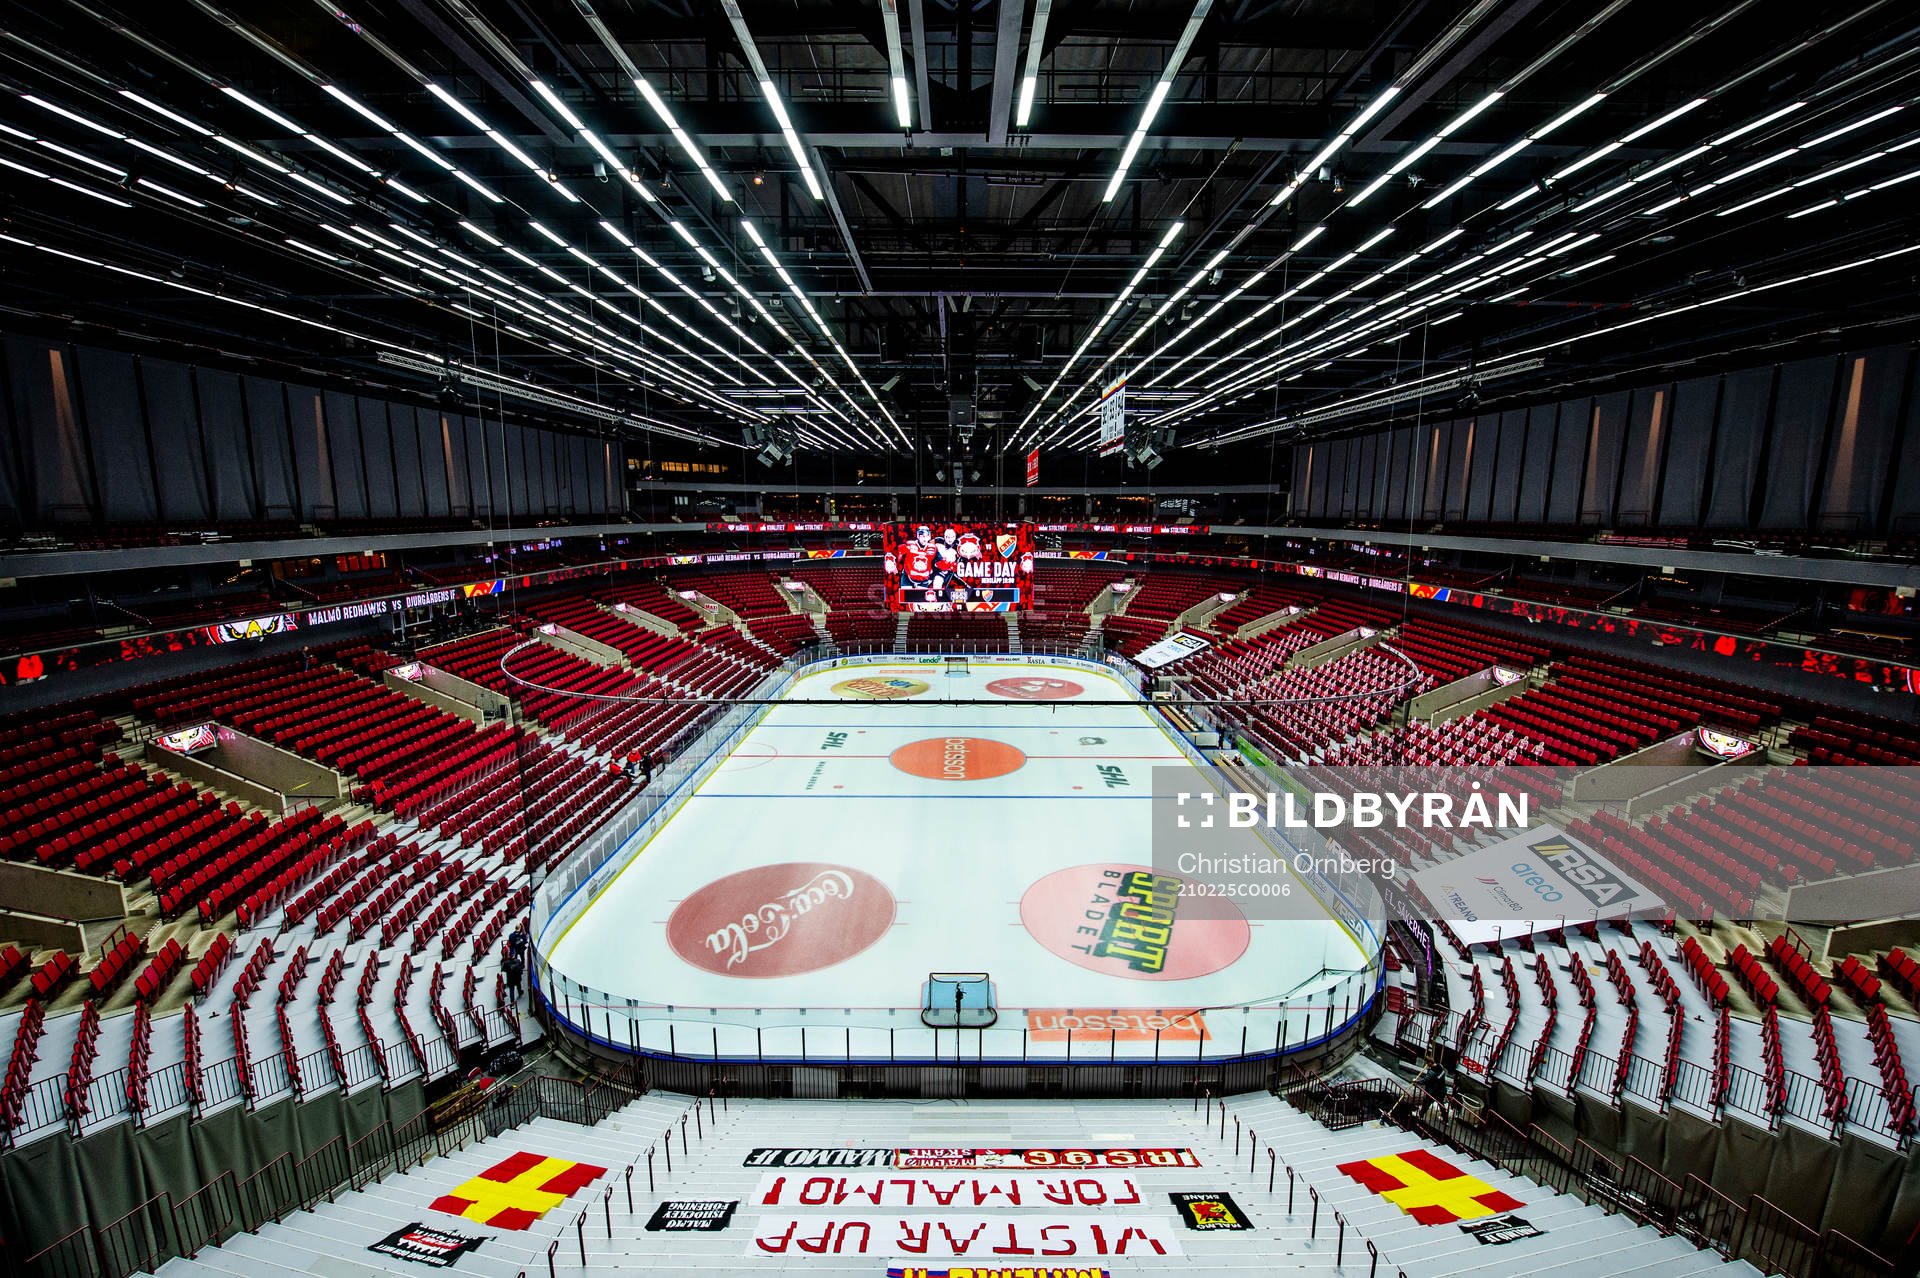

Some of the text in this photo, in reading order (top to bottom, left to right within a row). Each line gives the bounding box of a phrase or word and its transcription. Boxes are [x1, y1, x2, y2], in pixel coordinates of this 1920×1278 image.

[956, 561, 1016, 578] GAME DAY
[1326, 570, 1340, 580] MALMÖ
[1340, 572, 1360, 585] REDHAWKS
[309, 589, 456, 625] MALMÖ REDHAWKS VS DJURGÅRDENS IF
[918, 656, 938, 664] Lendo
[225, 732, 236, 740] 14
[821, 731, 848, 750] SHL
[1678, 737, 1695, 746] A 7
[944, 738, 971, 780] betsson
[1096, 764, 1131, 788] SHL
[1511, 862, 1563, 904] areco
[1548, 851, 1622, 906] RSA
[1448, 892, 1478, 923] TREANO
[1492, 886, 1523, 912] Climat80
[705, 870, 855, 970] Coca-Cola
[1071, 869, 1121, 955] BLADET
[1103, 870, 1185, 972] SPORT
[1035, 1014, 1201, 1035] betsson
[746, 1148, 782, 1166] IF
[662, 1210, 726, 1219] ISHOCKEY
[668, 1202, 730, 1211] FÖRENING
[755, 1220, 871, 1254] UPP
[1090, 1223, 1167, 1255] VI
